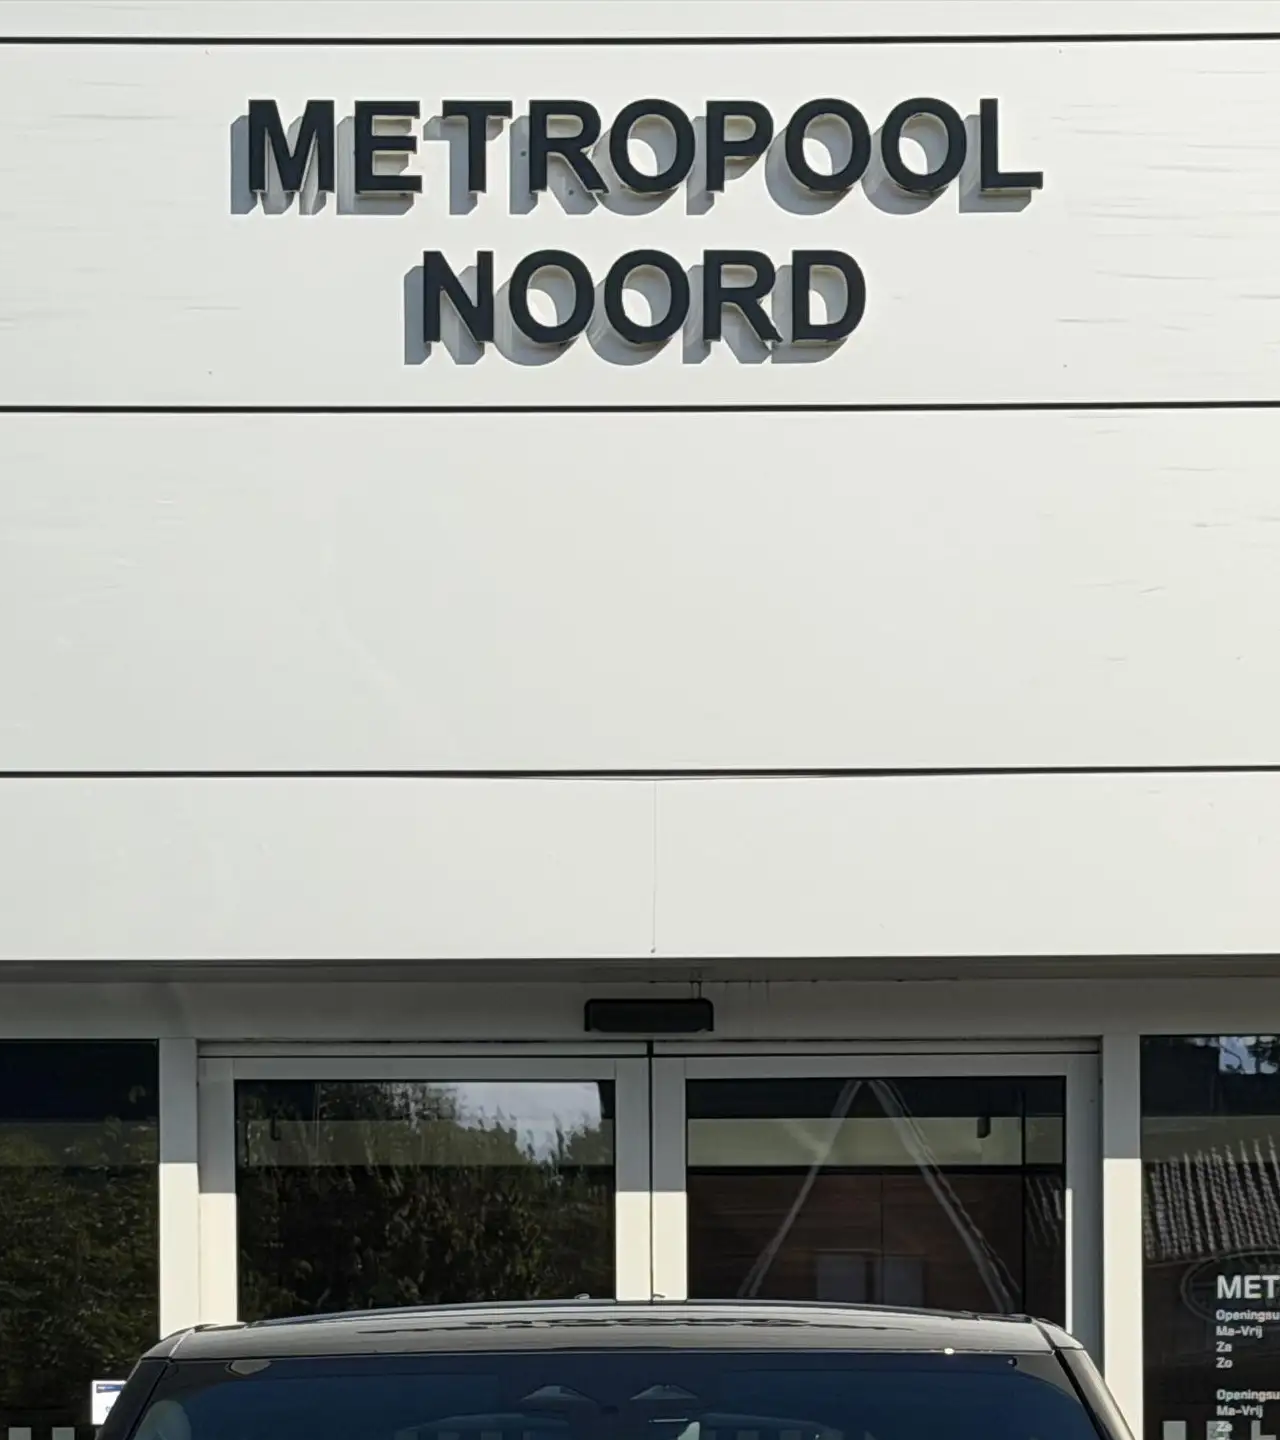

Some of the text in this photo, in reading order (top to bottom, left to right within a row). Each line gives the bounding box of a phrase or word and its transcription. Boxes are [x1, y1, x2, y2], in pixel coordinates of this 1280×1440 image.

[246, 97, 1044, 195] METROPOOL
[422, 250, 867, 345] NOORD
[1216, 1357, 1233, 1369] Zo
